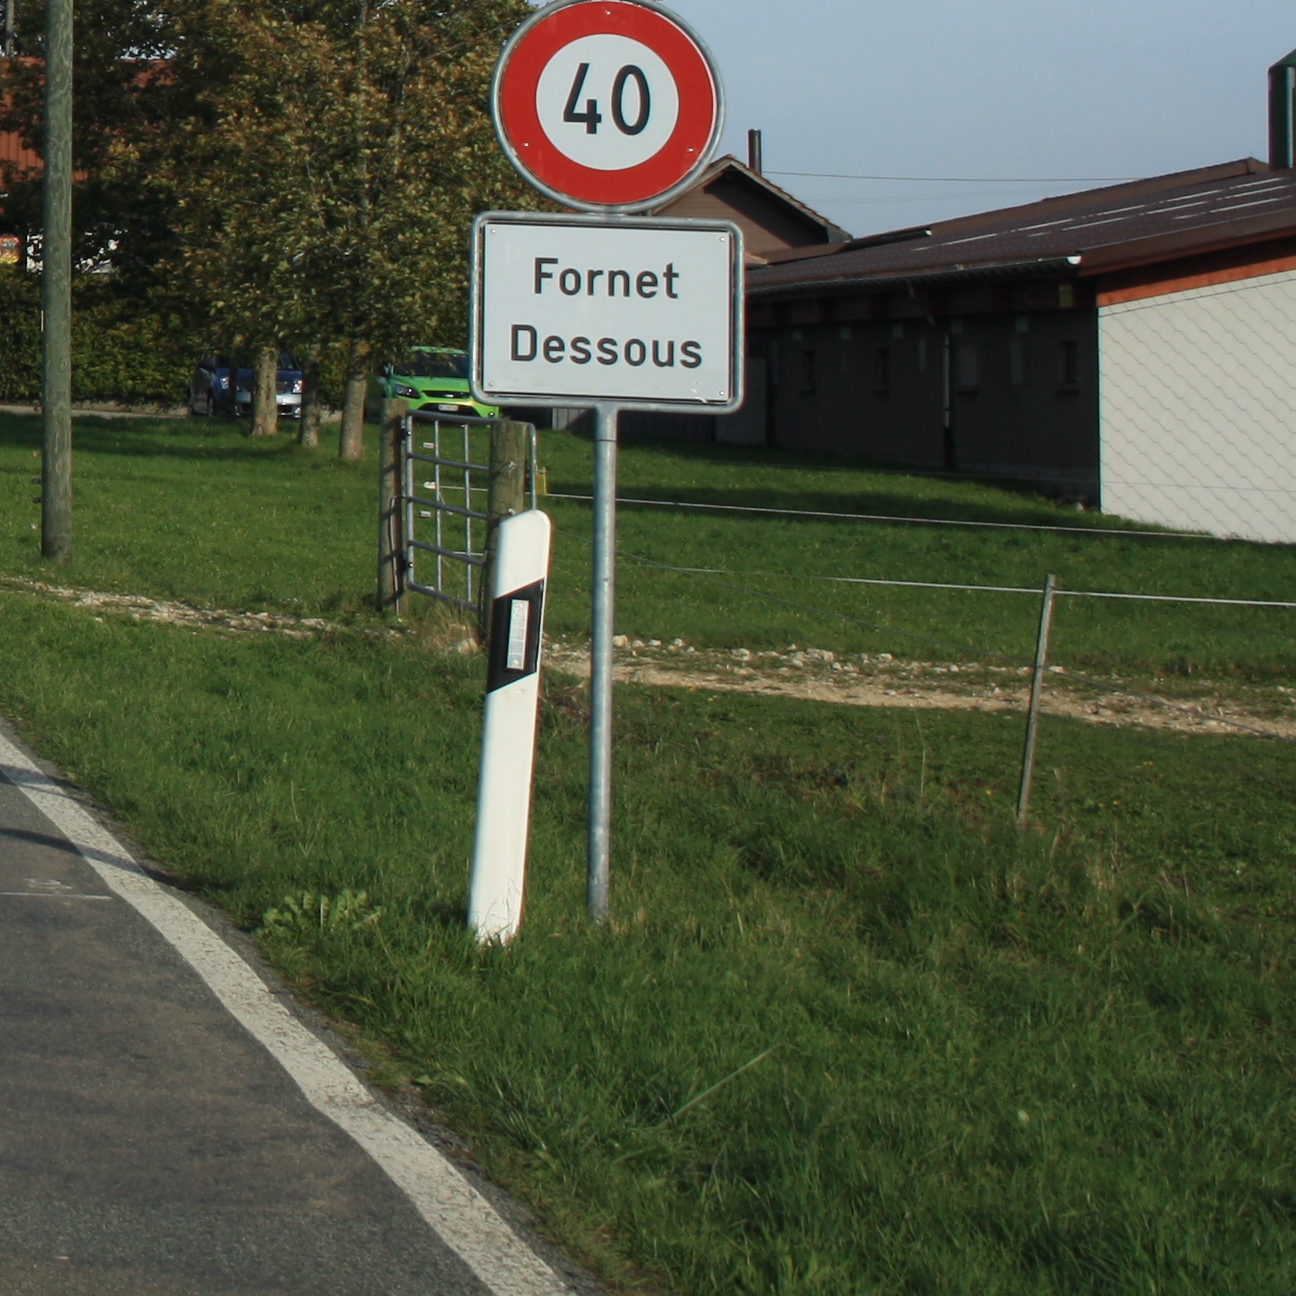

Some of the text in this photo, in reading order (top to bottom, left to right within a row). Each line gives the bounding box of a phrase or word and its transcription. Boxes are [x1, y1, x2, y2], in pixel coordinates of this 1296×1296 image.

[563, 62, 650, 135] 40
[534, 257, 680, 299] Fornet
[511, 324, 703, 369] Dessous
